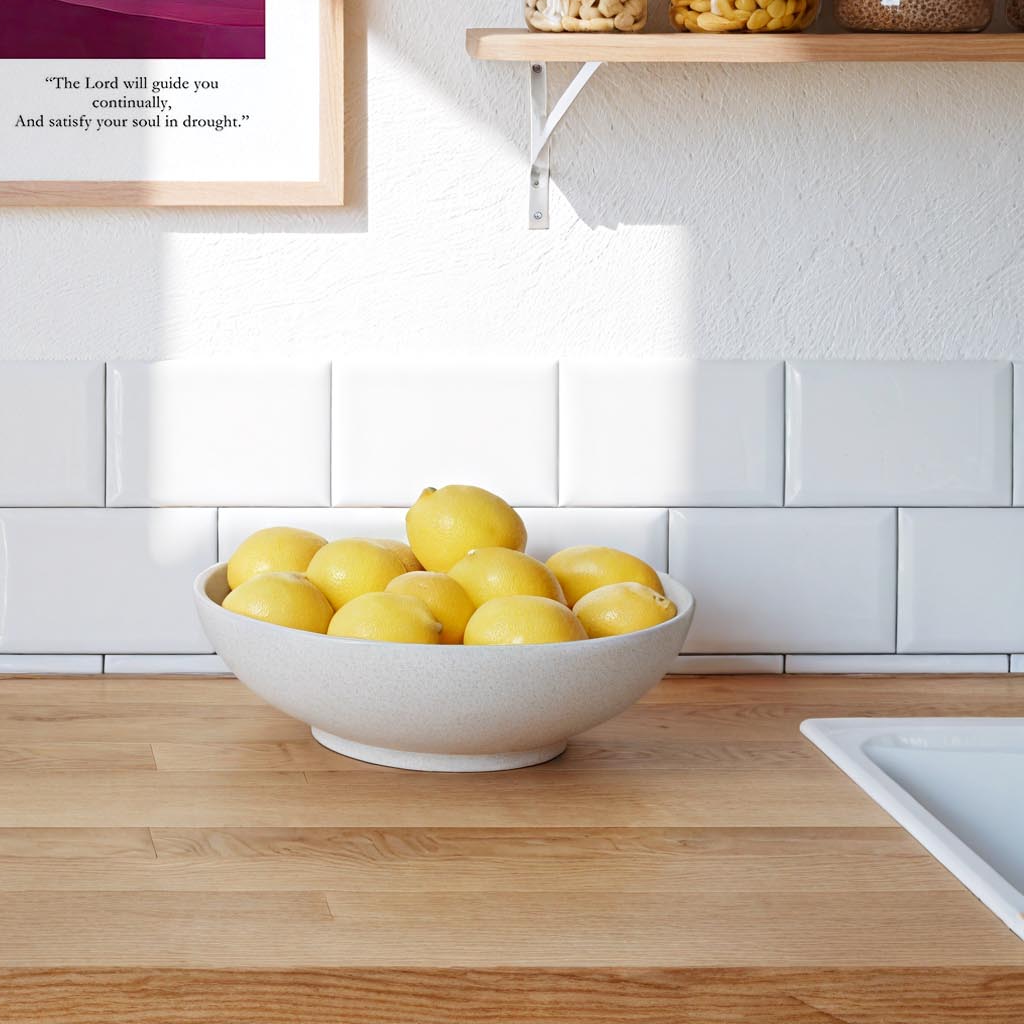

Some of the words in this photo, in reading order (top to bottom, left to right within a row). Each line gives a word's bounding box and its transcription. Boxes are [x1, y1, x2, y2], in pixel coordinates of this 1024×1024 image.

[44, 76, 80, 90] “The
[84, 76, 118, 90] Lord
[122, 76, 148, 90] will
[152, 76, 190, 94] guide
[193, 81, 219, 94] you
[91, 95, 172, 113] continually,
[14, 114, 45, 128] And
[48, 114, 93, 132] satisfy
[96, 119, 129, 132] your
[132, 114, 161, 128] soul
[164, 114, 179, 128] in
[182, 114, 250, 132] drought.”
